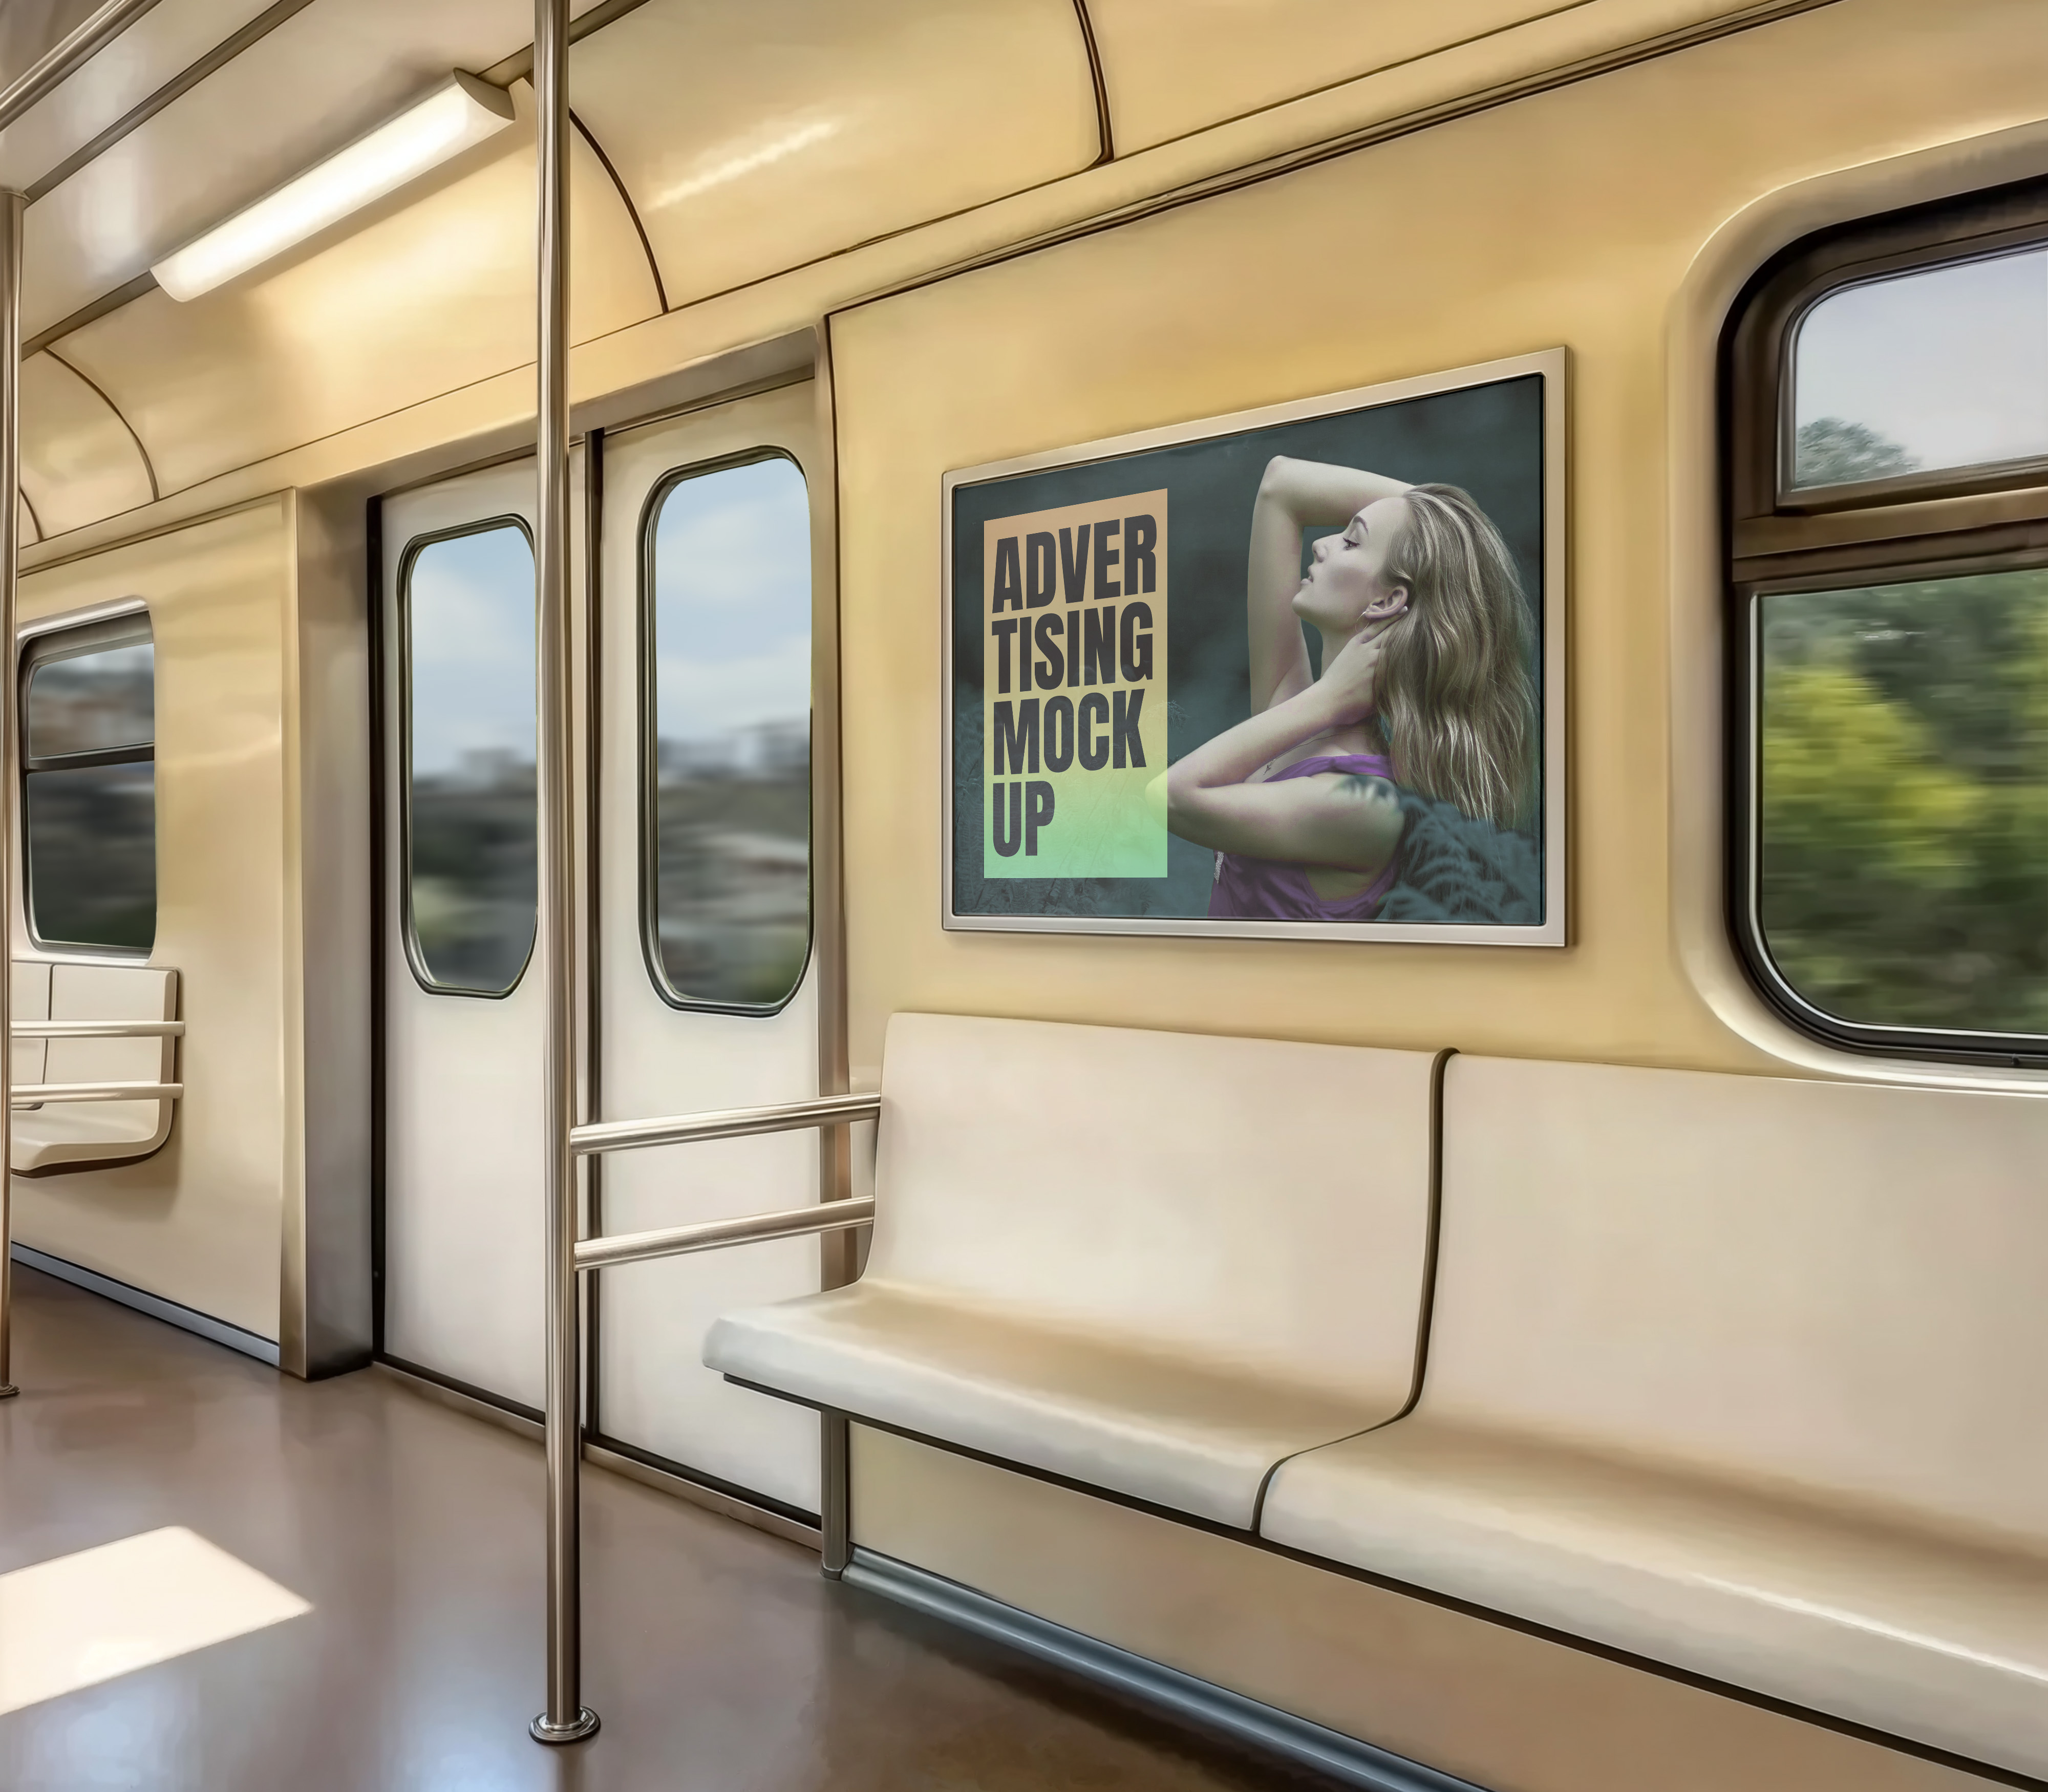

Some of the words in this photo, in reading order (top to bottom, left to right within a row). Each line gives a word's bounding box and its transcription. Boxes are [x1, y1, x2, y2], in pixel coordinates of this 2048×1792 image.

[992, 515, 1157, 613] ADVER
[992, 602, 1153, 694] TISING
[993, 689, 1146, 775] MOCK
[993, 781, 1055, 857] UP
